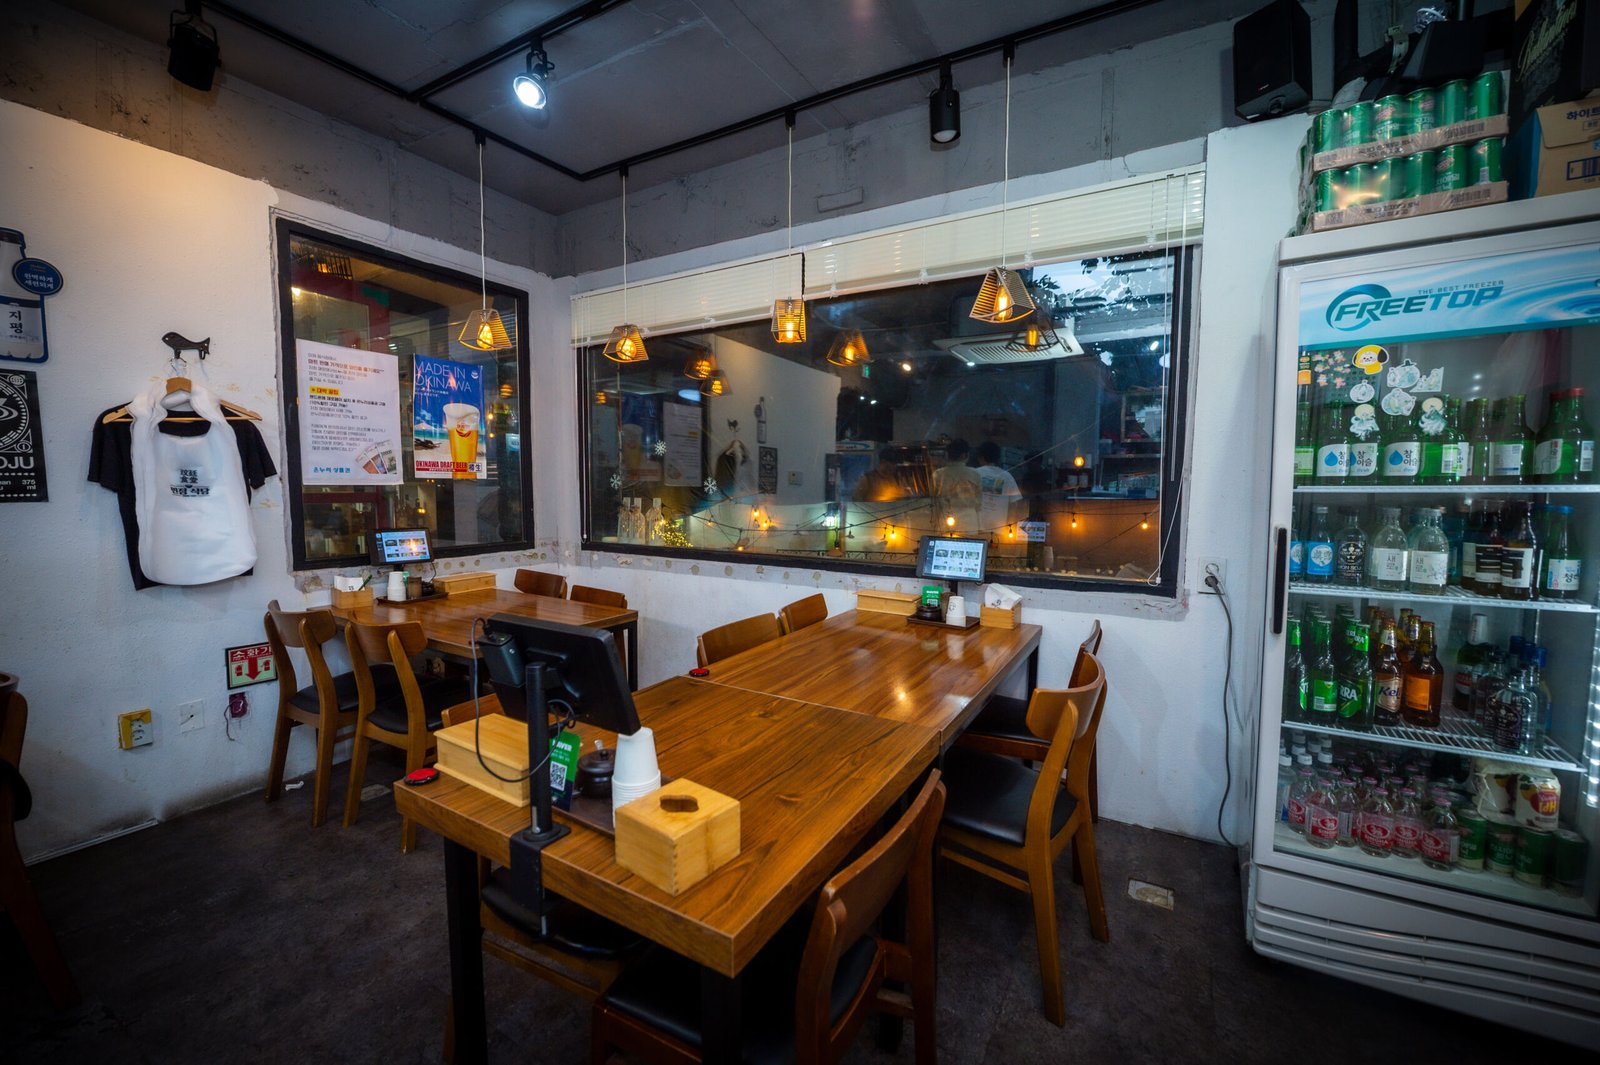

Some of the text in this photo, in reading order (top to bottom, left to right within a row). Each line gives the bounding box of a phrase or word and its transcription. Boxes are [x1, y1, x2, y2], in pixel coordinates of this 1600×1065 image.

[1566, 106, 1600, 120] 하이트
[1463, 280, 1504, 290] FREEZER
[1334, 286, 1504, 322] FREETOP
[9, 310, 23, 334] 지평
[415, 361, 449, 376] MADE
[454, 366, 466, 380] IN
[415, 374, 472, 392] OKINAWA
[232, 646, 272, 659] 소화기
